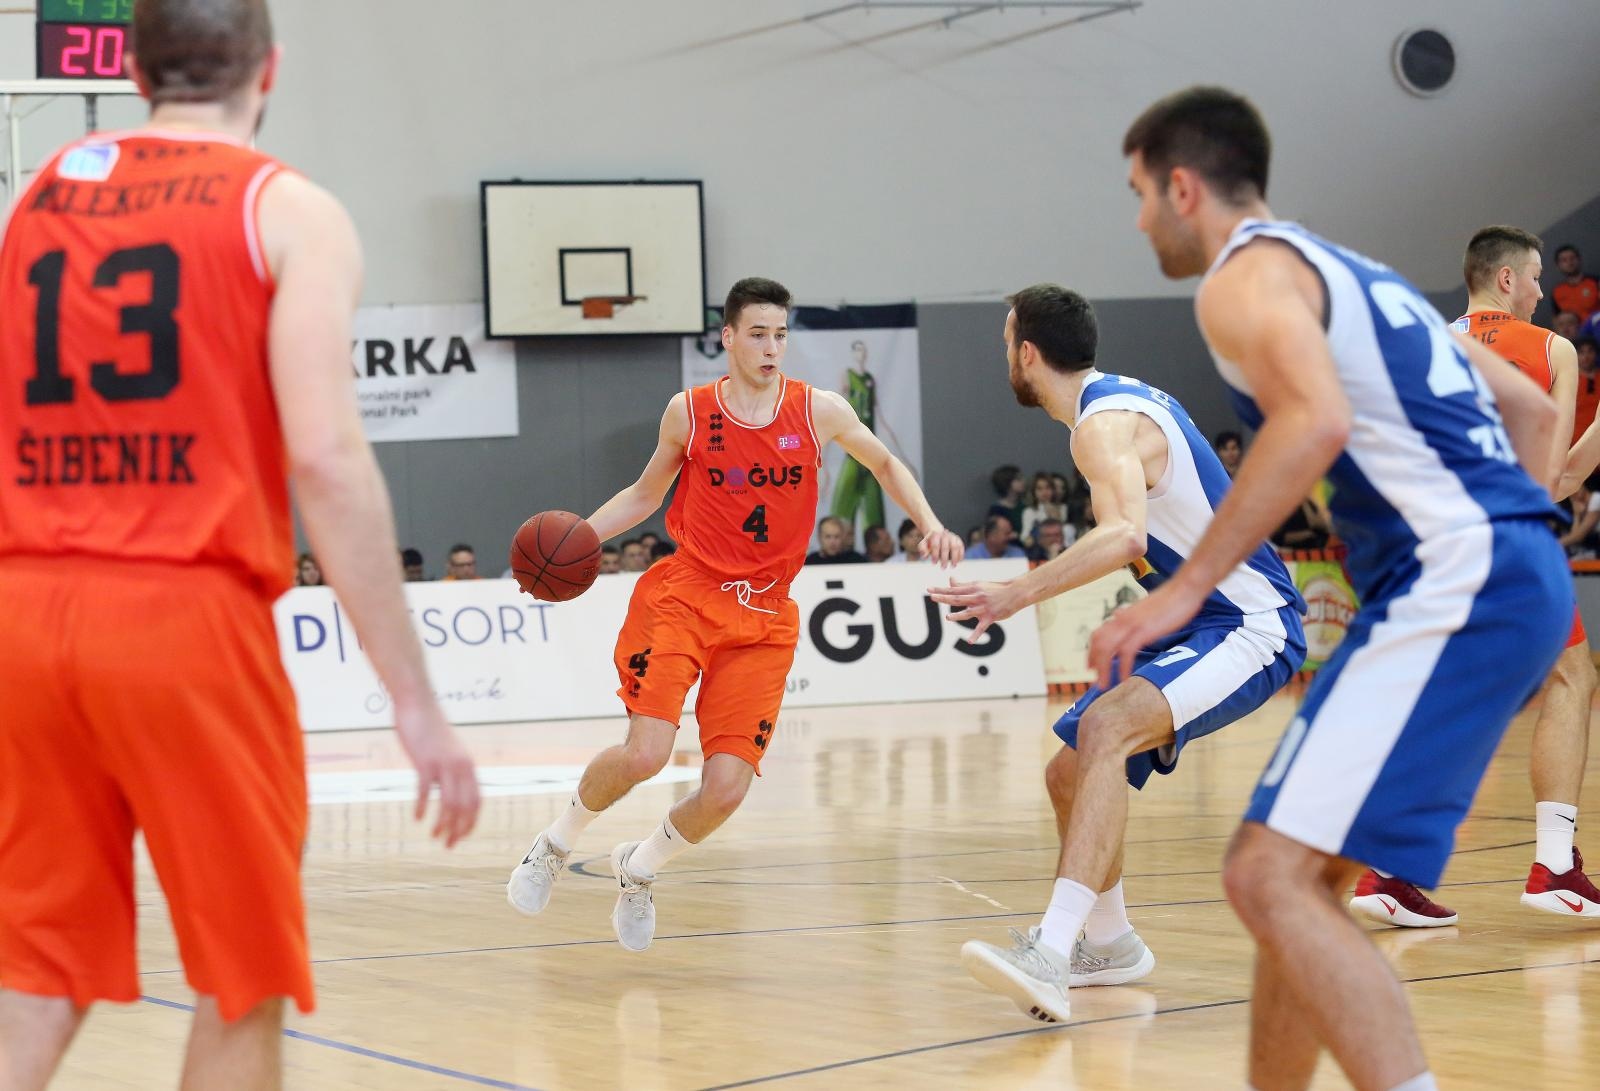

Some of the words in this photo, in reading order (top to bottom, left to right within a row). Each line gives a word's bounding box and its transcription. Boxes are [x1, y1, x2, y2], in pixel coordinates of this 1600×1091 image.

[61, 26, 124, 76] 20
[26, 242, 182, 405] 13
[16, 426, 196, 486] ŠIBENIK
[742, 504, 769, 543] 4
[628, 647, 652, 678] 4
